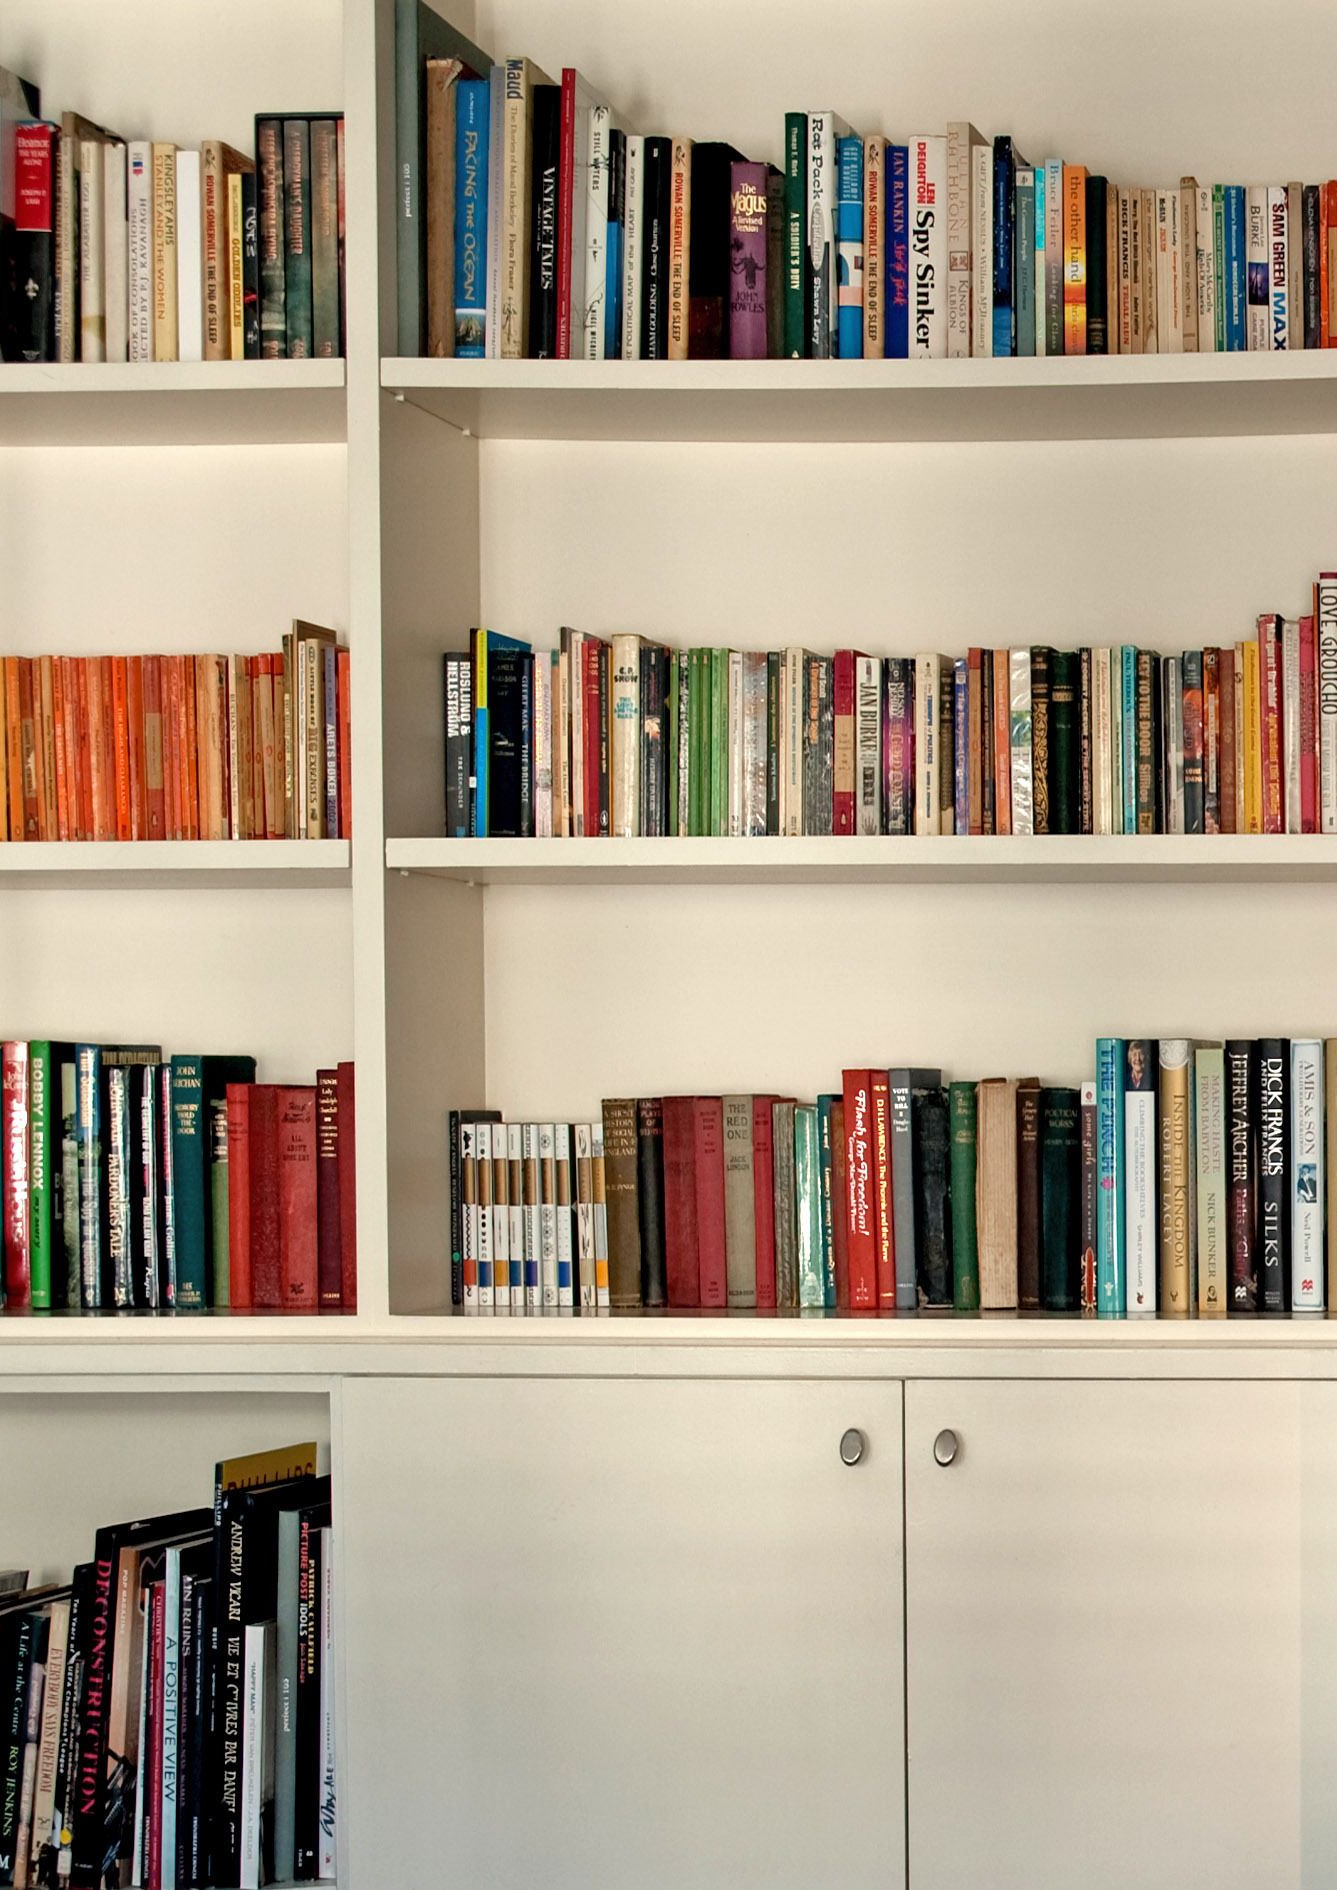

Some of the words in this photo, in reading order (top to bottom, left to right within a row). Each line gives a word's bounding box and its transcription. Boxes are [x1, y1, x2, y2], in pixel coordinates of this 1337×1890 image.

[812, 119, 823, 150] Rat
[156, 154, 164, 207] STANLEY
[464, 131, 478, 198] FACING
[813, 155, 823, 199] Pack
[894, 152, 904, 175] IAN
[917, 142, 926, 204] DEIGHTON
[165, 154, 174, 215] KINGSLEY
[207, 175, 216, 206] ROWAN
[543, 167, 555, 234] VINTAGE
[675, 172, 683, 204] ROWAN
[869, 171, 877, 202] ROWAN
[927, 183, 935, 204] LEN
[948, 132, 959, 241] RATHBONE
[1070, 176, 1080, 199] the
[156, 208, 164, 238] AND
[894, 181, 904, 232] RANKIN
[1070, 203, 1081, 241] other
[1251, 205, 1260, 247] BURKE
[1272, 204, 1285, 236] SAM
[165, 216, 175, 245] AMIS
[207, 209, 216, 261] SOMERVILLE
[674, 206, 683, 259] SOMERVILLE
[869, 205, 877, 258] SOMERVILLE
[913, 211, 934, 256] Spy
[157, 243, 165, 264] THE
[208, 265, 216, 281] THE
[463, 233, 478, 301] OCEAN
[541, 240, 554, 290] TALES
[673, 263, 681, 279] THE
[869, 262, 877, 277] THE
[1070, 246, 1082, 282] hand
[1273, 242, 1285, 286] GREEN
[157, 270, 165, 320] WOMEN
[208, 284, 216, 301] END
[208, 304, 216, 314] OF
[673, 281, 681, 298] END
[673, 302, 681, 312] OF
[869, 300, 876, 311] OF
[916, 264, 935, 348] Sinker
[958, 280, 968, 317] KINGS
[208, 317, 217, 344] SLEEP
[673, 315, 681, 341] SLEEP
[812, 319, 820, 344] Levy
[959, 321, 967, 334] OF
[1273, 293, 1286, 350] MAX
[1320, 586, 1334, 635] LOVE,
[460, 662, 470, 722] ROSLUND
[1321, 637, 1336, 714] GROUCHO
[447, 661, 458, 737] HELLSTRÖM
[860, 683, 877, 709] JAN
[461, 726, 470, 735] &
[860, 711, 876, 751] BURKE
[33, 1058, 43, 1115] BOBBY
[1201, 1075, 1209, 1112] FROM
[1229, 1053, 1247, 1116] JEFFREY
[1267, 1059, 1282, 1105] DICK
[1304, 1061, 1313, 1100] AMIS
[853, 1090, 865, 1136] Flash
[1211, 1075, 1220, 1128] MAKING
[1304, 1105, 1313, 1118] &
[1173, 1095, 1185, 1150] INSIDE
[1268, 1109, 1283, 1175] FRANCIS
[1304, 1122, 1314, 1155] SON
[33, 1122, 43, 1190] LENNOX
[857, 1139, 867, 1159] for
[1163, 1118, 1171, 1184] ROBERT
[1201, 1116, 1209, 1174] BABYLON
[1212, 1131, 1220, 1173] HASTE
[1231, 1118, 1249, 1182] ARCHER
[1175, 1156, 1183, 1178] THE
[34, 1196, 39, 1214] my
[858, 1162, 869, 1235] Freedom!
[1207, 1193, 1216, 1224] NICK
[1163, 1193, 1172, 1245] LACEY
[1174, 1185, 1185, 1268] KINGDOM
[1265, 1202, 1278, 1267] SILKS
[1207, 1227, 1216, 1278] BUNKER
[230, 1521, 243, 1575] ANDREW
[300, 1522, 308, 1569] PICTURE
[228, 1582, 241, 1621] VICARI
[300, 1572, 308, 1600] POST
[20, 1622, 28, 1630] A
[166, 1637, 177, 1650] A
[19, 1635, 29, 1657] Life
[227, 1637, 241, 1656] VIE
[16, 1676, 25, 1693] the
[17, 1662, 24, 1671] at
[45, 1648, 63, 1711] EVERYBODY
[227, 1662, 240, 1677] ET
[80, 1560, 112, 1814] DECONSTRUCTION
[166, 1661, 177, 1745] POSITIVE
[11, 1698, 24, 1735] Centre
[43, 1713, 59, 1738] SAYS
[8, 1746, 19, 1773] ROY
[40, 1741, 57, 1792] FREEDOM
[224, 1741, 237, 1764] PAR
[164, 1753, 176, 1802] VIEW
[3, 1777, 17, 1836] JENKINS
